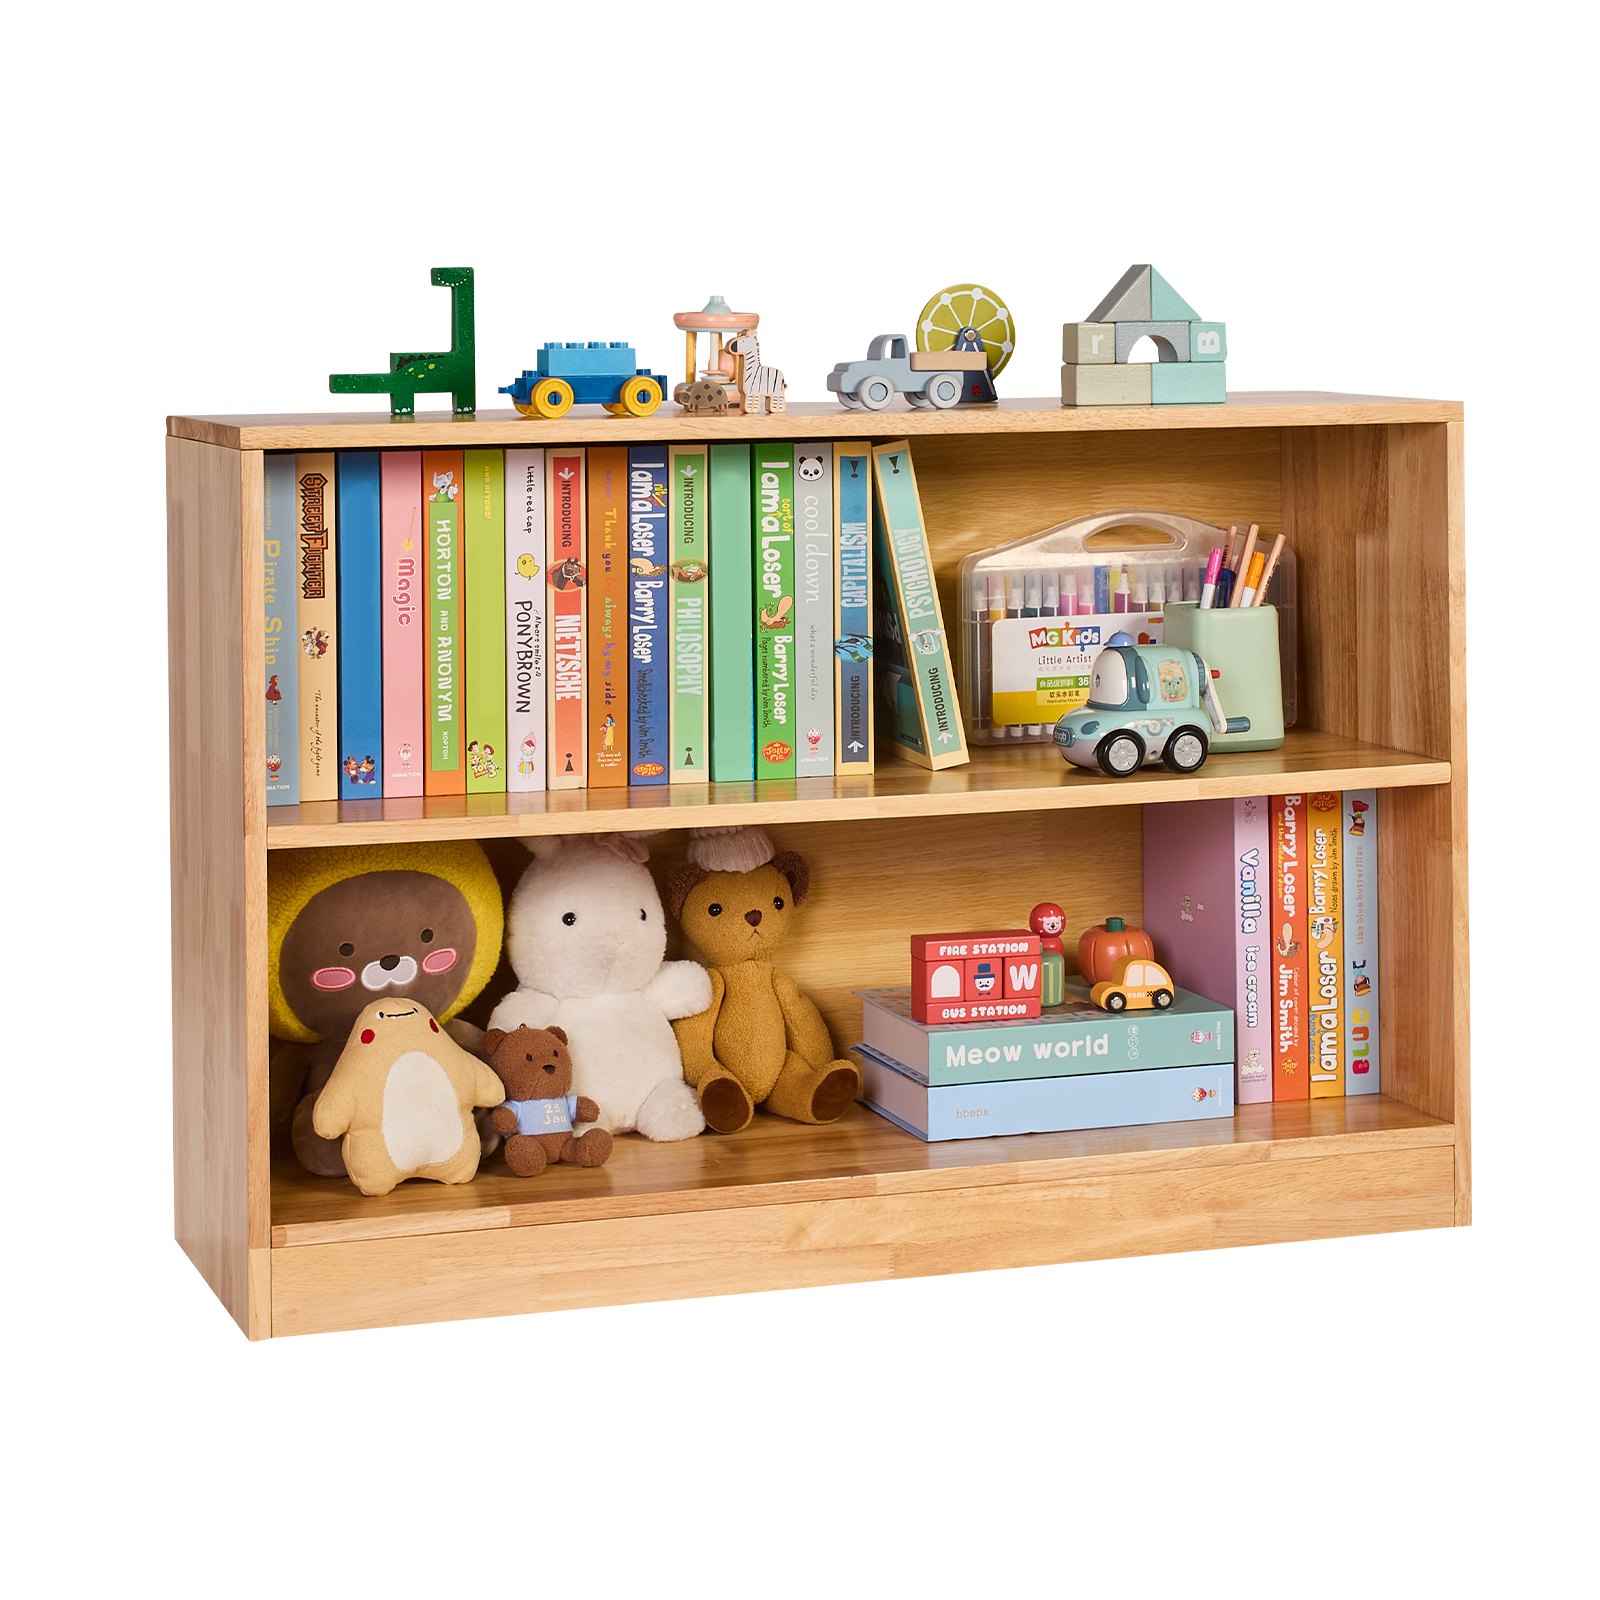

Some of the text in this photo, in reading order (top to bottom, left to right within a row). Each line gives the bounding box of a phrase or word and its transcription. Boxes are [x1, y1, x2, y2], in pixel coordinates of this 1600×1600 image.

[1091, 334, 1104, 354] r
[1197, 331, 1220, 354] B
[523, 465, 535, 534] Little red cap
[631, 470, 653, 498] am
[761, 473, 780, 513] am
[562, 480, 572, 548] INTRODUCING
[631, 500, 652, 512] a
[684, 478, 694, 544] INTRODUCING
[761, 516, 780, 532] a
[782, 498, 794, 534] sort of
[299, 473, 328, 599] STREET FIGHTER
[604, 508, 617, 550] Thank
[631, 513, 666, 557] Loser
[436, 519, 452, 601] HORTON
[602, 553, 612, 573] you
[761, 536, 790, 598] Loser
[804, 495, 830, 604] cool down
[840, 522, 868, 608] CAPITALISM
[393, 557, 416, 627] Magic
[894, 528, 934, 620] PSYCHOLOGY
[263, 539, 282, 665] Pirate Ship
[440, 610, 448, 631] AND
[602, 598, 616, 638] always
[630, 580, 664, 624] Barry
[602, 642, 617, 656] by
[632, 625, 658, 664] Loser
[676, 598, 703, 696] PHILOSOPHY
[759, 637, 771, 654] Pages
[810, 624, 818, 642] what
[1031, 628, 1099, 647] MG Kids
[515, 600, 533, 713] PONYBROWN
[555, 614, 582, 700] NIETZSCHE
[602, 660, 612, 677] my
[762, 656, 770, 687] numbered
[810, 650, 818, 686] wonderful
[1038, 654, 1092, 665] Little Artist
[437, 636, 453, 722] ANONYM
[605, 682, 616, 705] side
[772, 635, 792, 724] Barry Loser
[809, 688, 818, 701] day
[1078, 677, 1089, 686] 36
[762, 709, 772, 728] Smith
[850, 675, 860, 740] INTRODUCING
[928, 667, 948, 732] INTRODUCING
[1282, 796, 1302, 918] Barry Loser
[1329, 828, 1338, 847] Smith
[1329, 848, 1338, 861] Jim
[1240, 848, 1261, 934] Vanilla
[1308, 828, 1328, 915] Barry Loser
[1330, 895, 1338, 913] Noses
[940, 942, 1028, 956] FIRE STATION
[1009, 963, 1038, 992] W
[1246, 945, 1260, 1028] ice cream
[942, 1004, 1027, 1019] BUS STATION
[1279, 964, 1293, 1053] Jim Smith
[1311, 950, 1338, 1082] I am a Loser
[946, 1033, 1109, 1068] Meow world
[544, 1104, 560, 1114] 25
[544, 1116, 567, 1125] Jan
